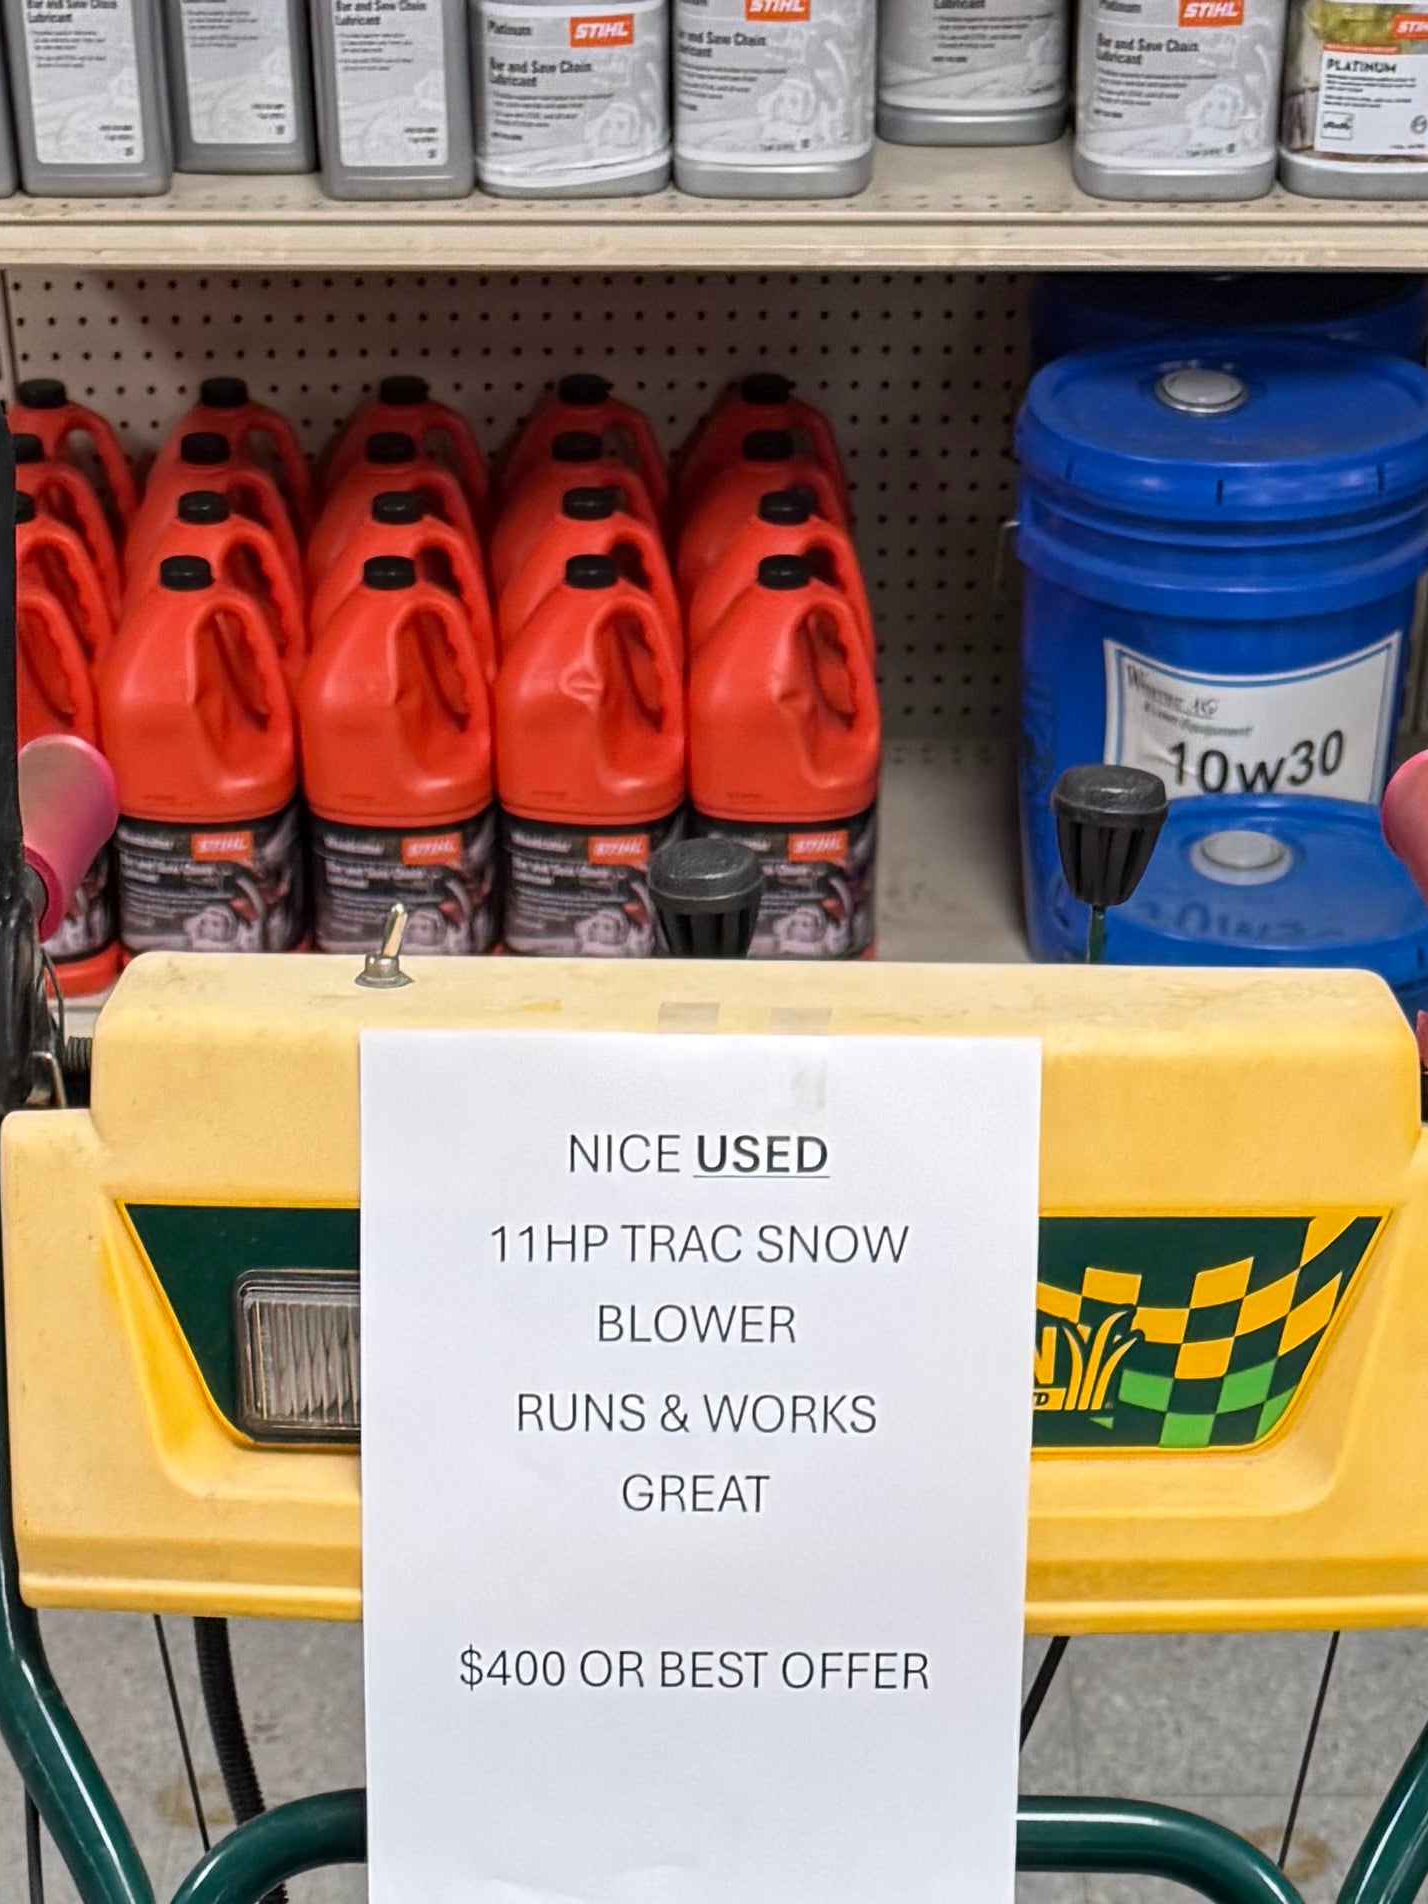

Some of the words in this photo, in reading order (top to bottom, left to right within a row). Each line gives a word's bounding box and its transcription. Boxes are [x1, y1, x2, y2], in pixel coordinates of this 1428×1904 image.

[1183, 0, 1240, 19] STIHL
[574, 23, 629, 40] STIHL
[1116, 38, 1135, 52] and
[1166, 40, 1200, 53] Chain
[1325, 59, 1398, 74] PLATINUM
[1167, 729, 1344, 794] 10w30
[566, 1133, 681, 1177] NICE
[693, 1133, 830, 1179] USED
[490, 1225, 608, 1266] 11HP
[620, 1222, 742, 1266] TRAC
[757, 1222, 910, 1266] SNOW
[597, 1303, 796, 1345] BLOWER
[515, 1393, 645, 1435] RUNS
[660, 1393, 693, 1435] &
[703, 1393, 878, 1435] WORKS
[620, 1473, 770, 1516] GREAT
[459, 1645, 565, 1693] $400
[578, 1649, 646, 1691] OR
[659, 1649, 769, 1691] BEST
[781, 1649, 931, 1693] OFFER
